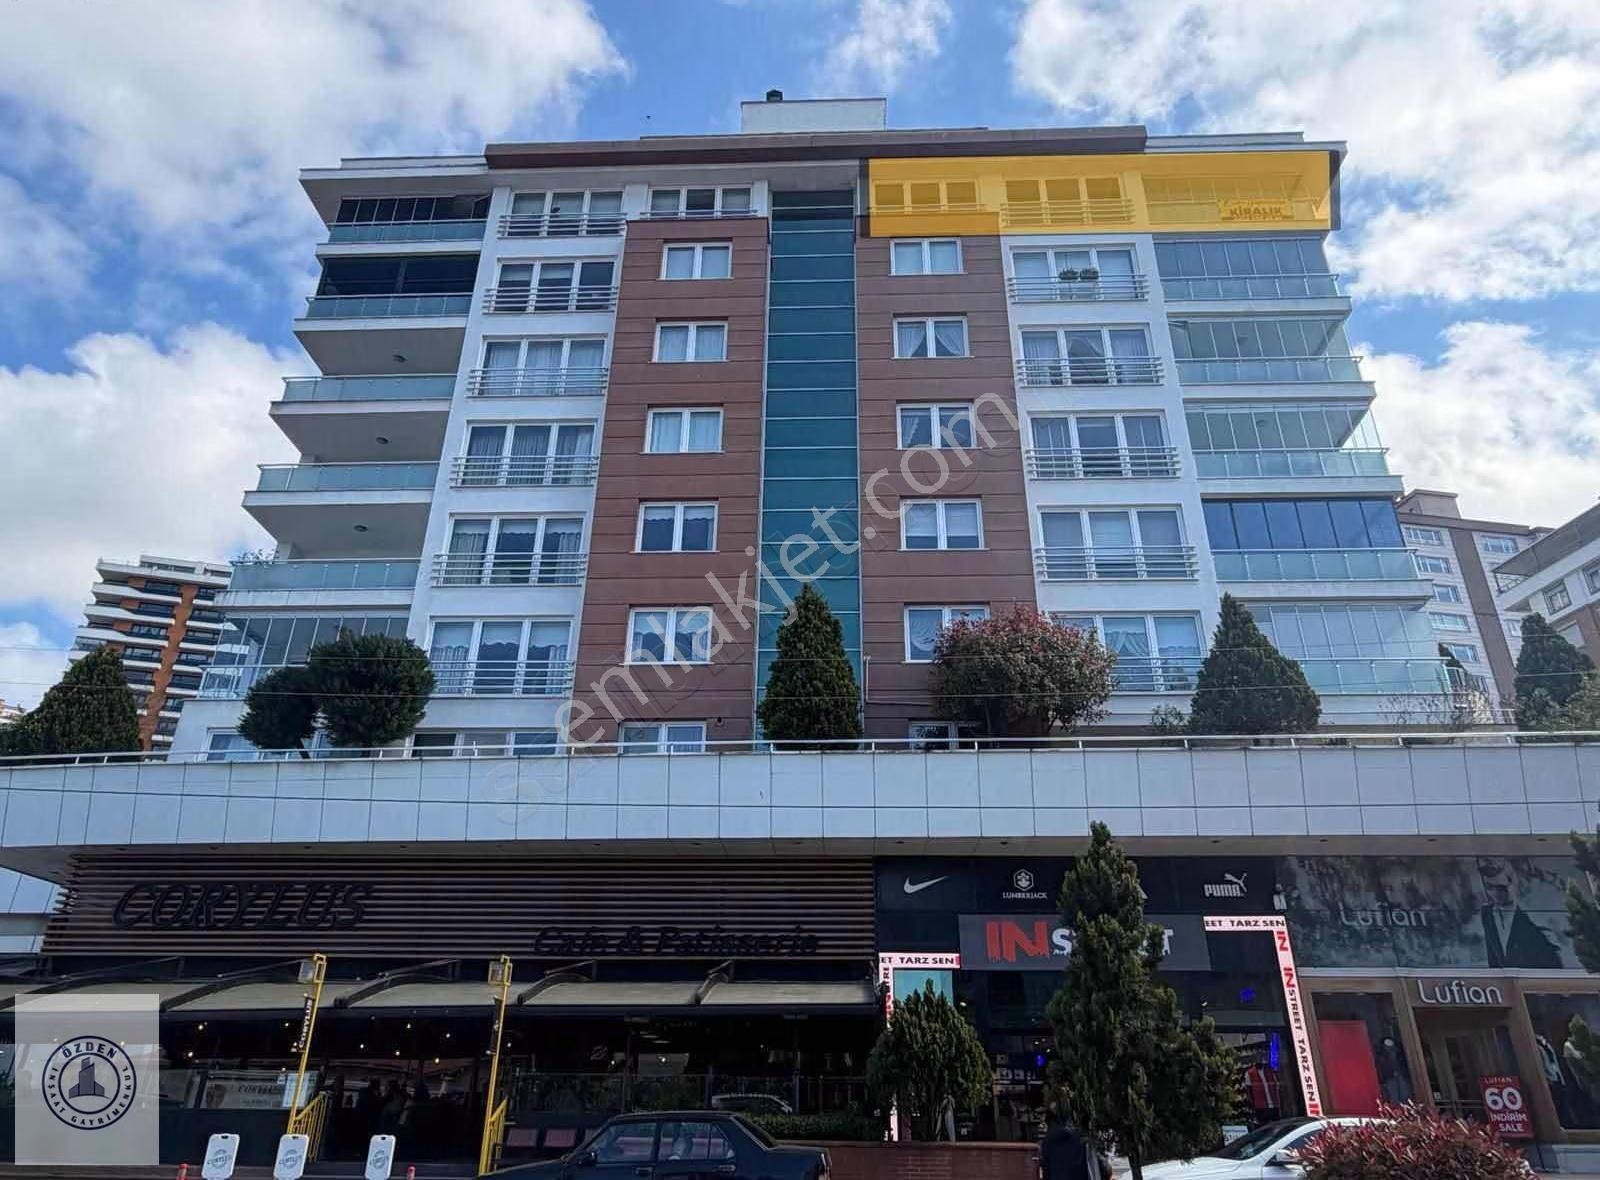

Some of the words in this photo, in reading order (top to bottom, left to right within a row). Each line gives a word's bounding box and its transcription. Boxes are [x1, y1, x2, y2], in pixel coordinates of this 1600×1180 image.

[1002, 891, 1048, 900] LUMBERJACK
[1204, 884, 1241, 897] PUMA
[113, 882, 373, 930] CORYLUS
[1338, 902, 1427, 927] Lufian
[1417, 979, 1502, 1004] Lufian
[1298, 1038, 1311, 1073] TARZ
[1304, 1075, 1316, 1102] SEN
[1485, 1087, 1522, 1111] 60
[1499, 1123, 1524, 1132] SALE
